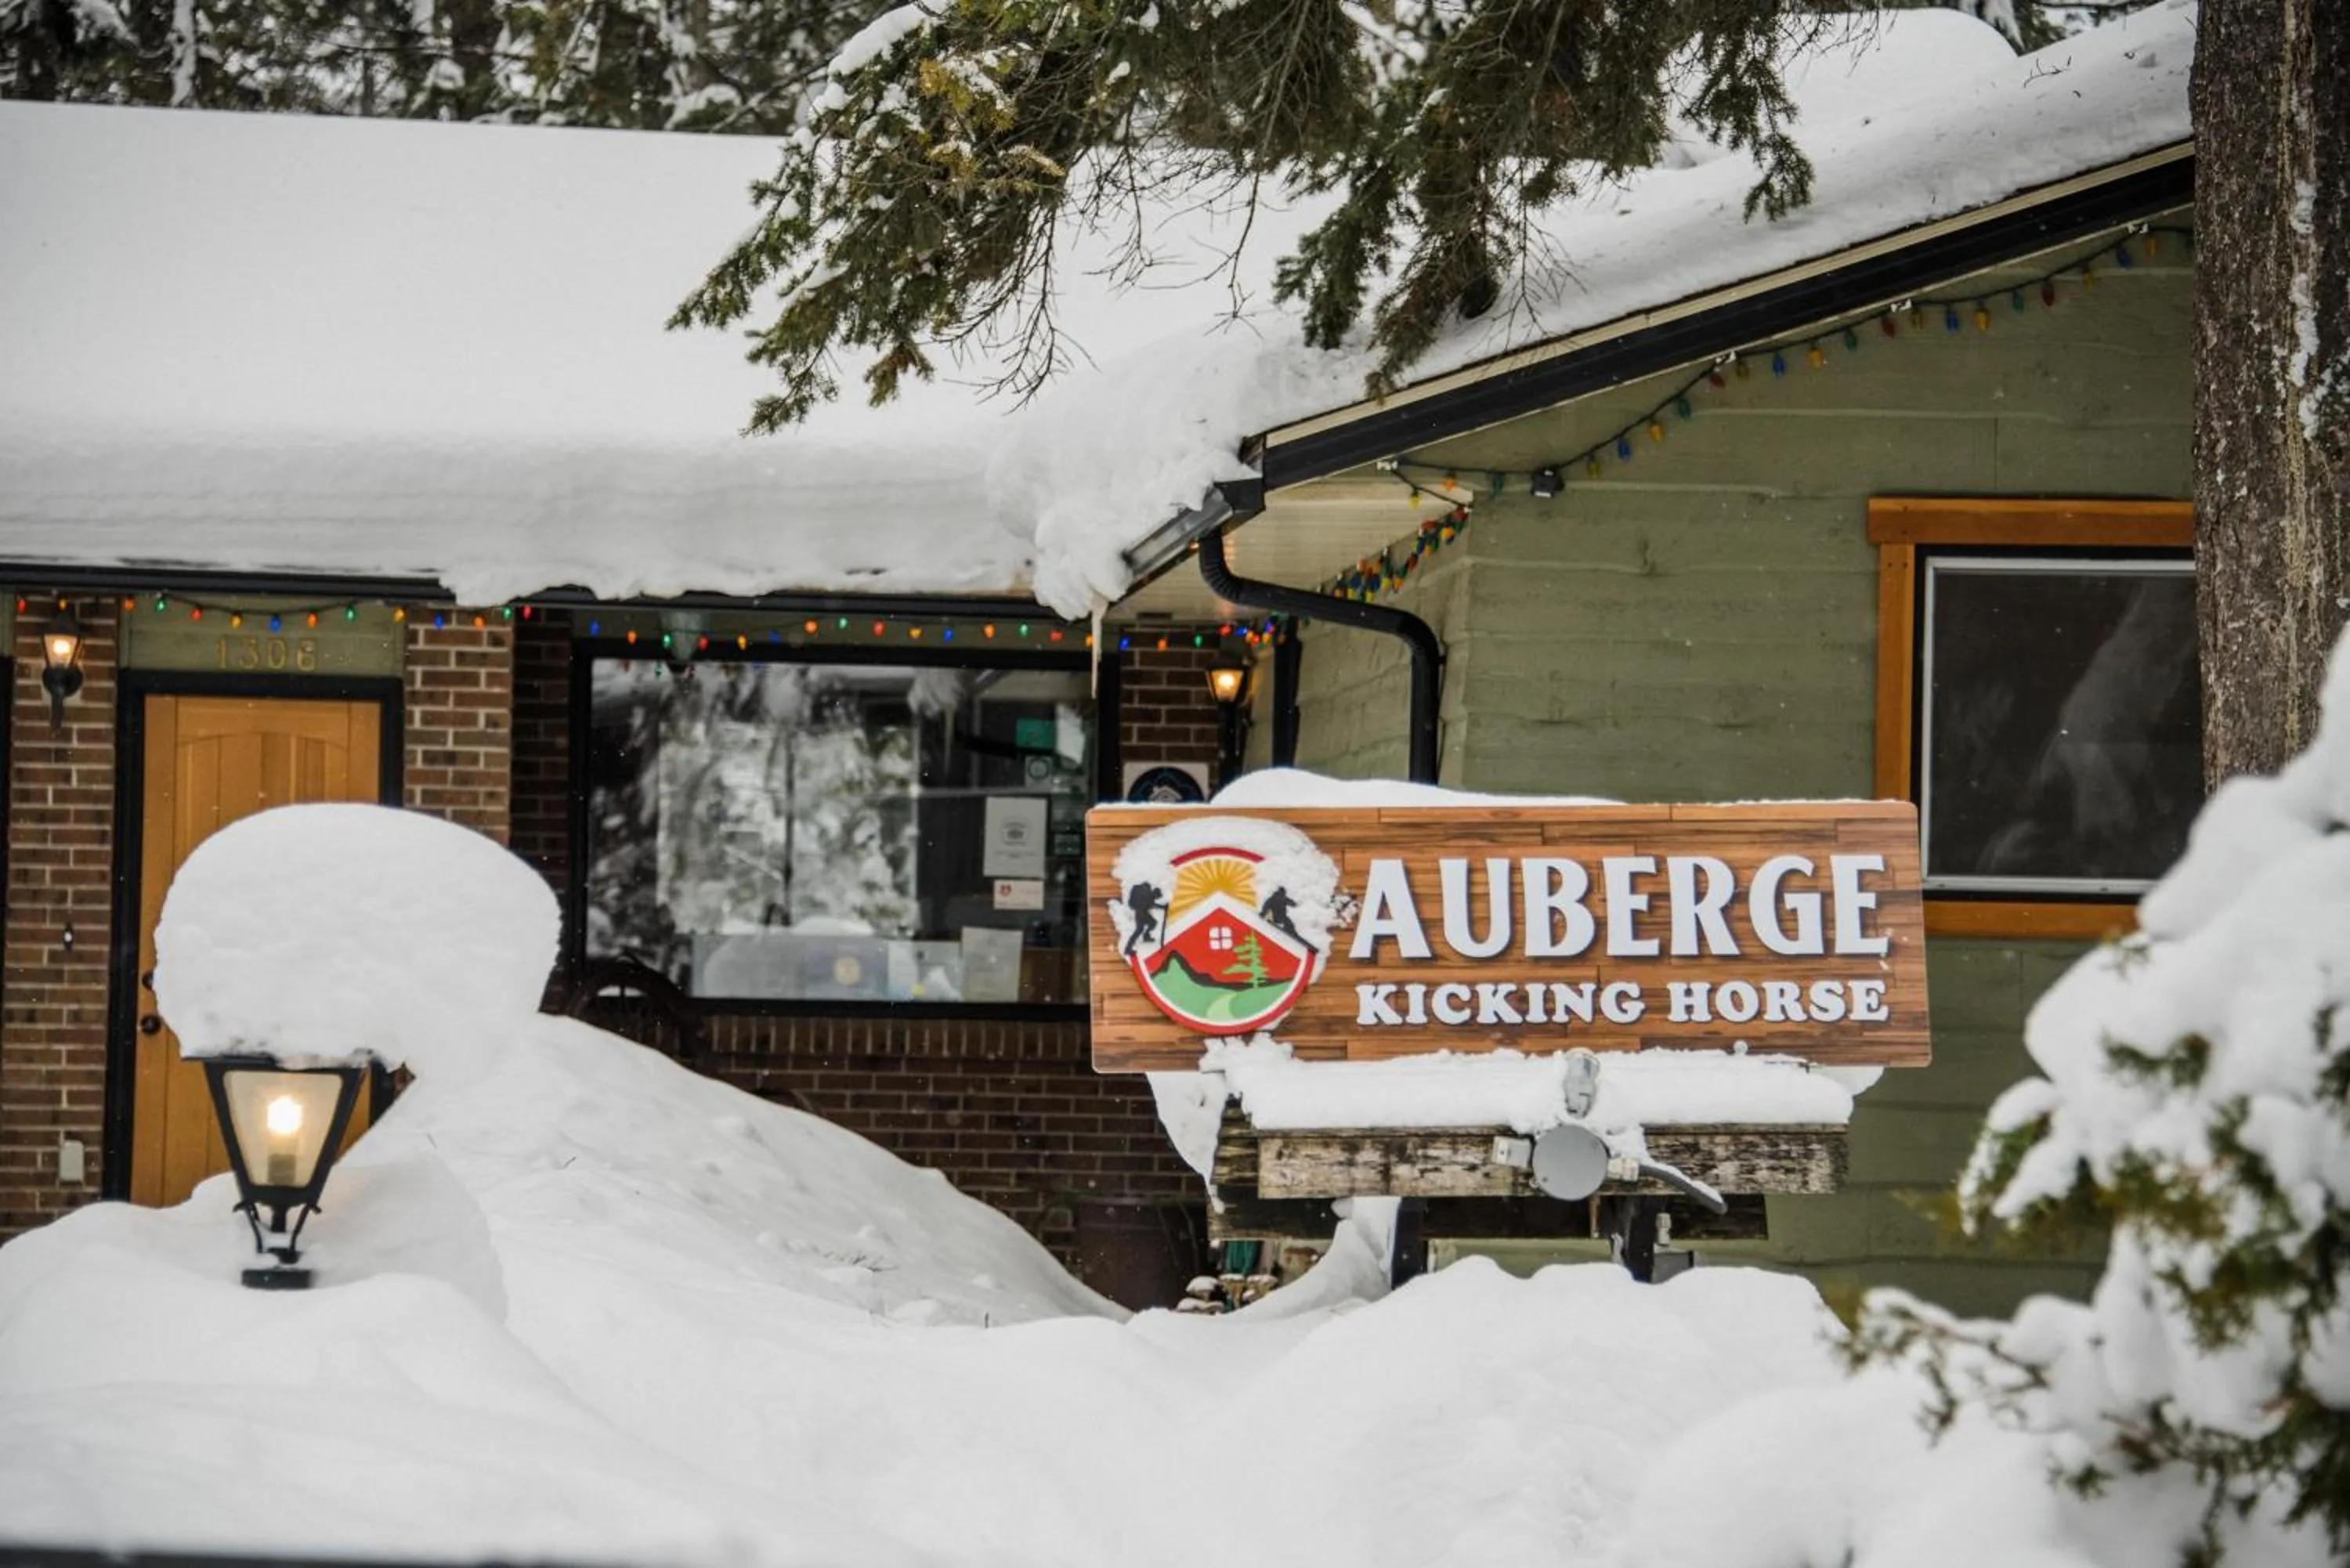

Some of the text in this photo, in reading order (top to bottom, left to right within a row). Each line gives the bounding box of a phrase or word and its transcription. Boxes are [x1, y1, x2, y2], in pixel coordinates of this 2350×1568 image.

[1348, 854, 1889, 959] AUBERGE
[1355, 980, 1889, 1025] KICKING HORSE
